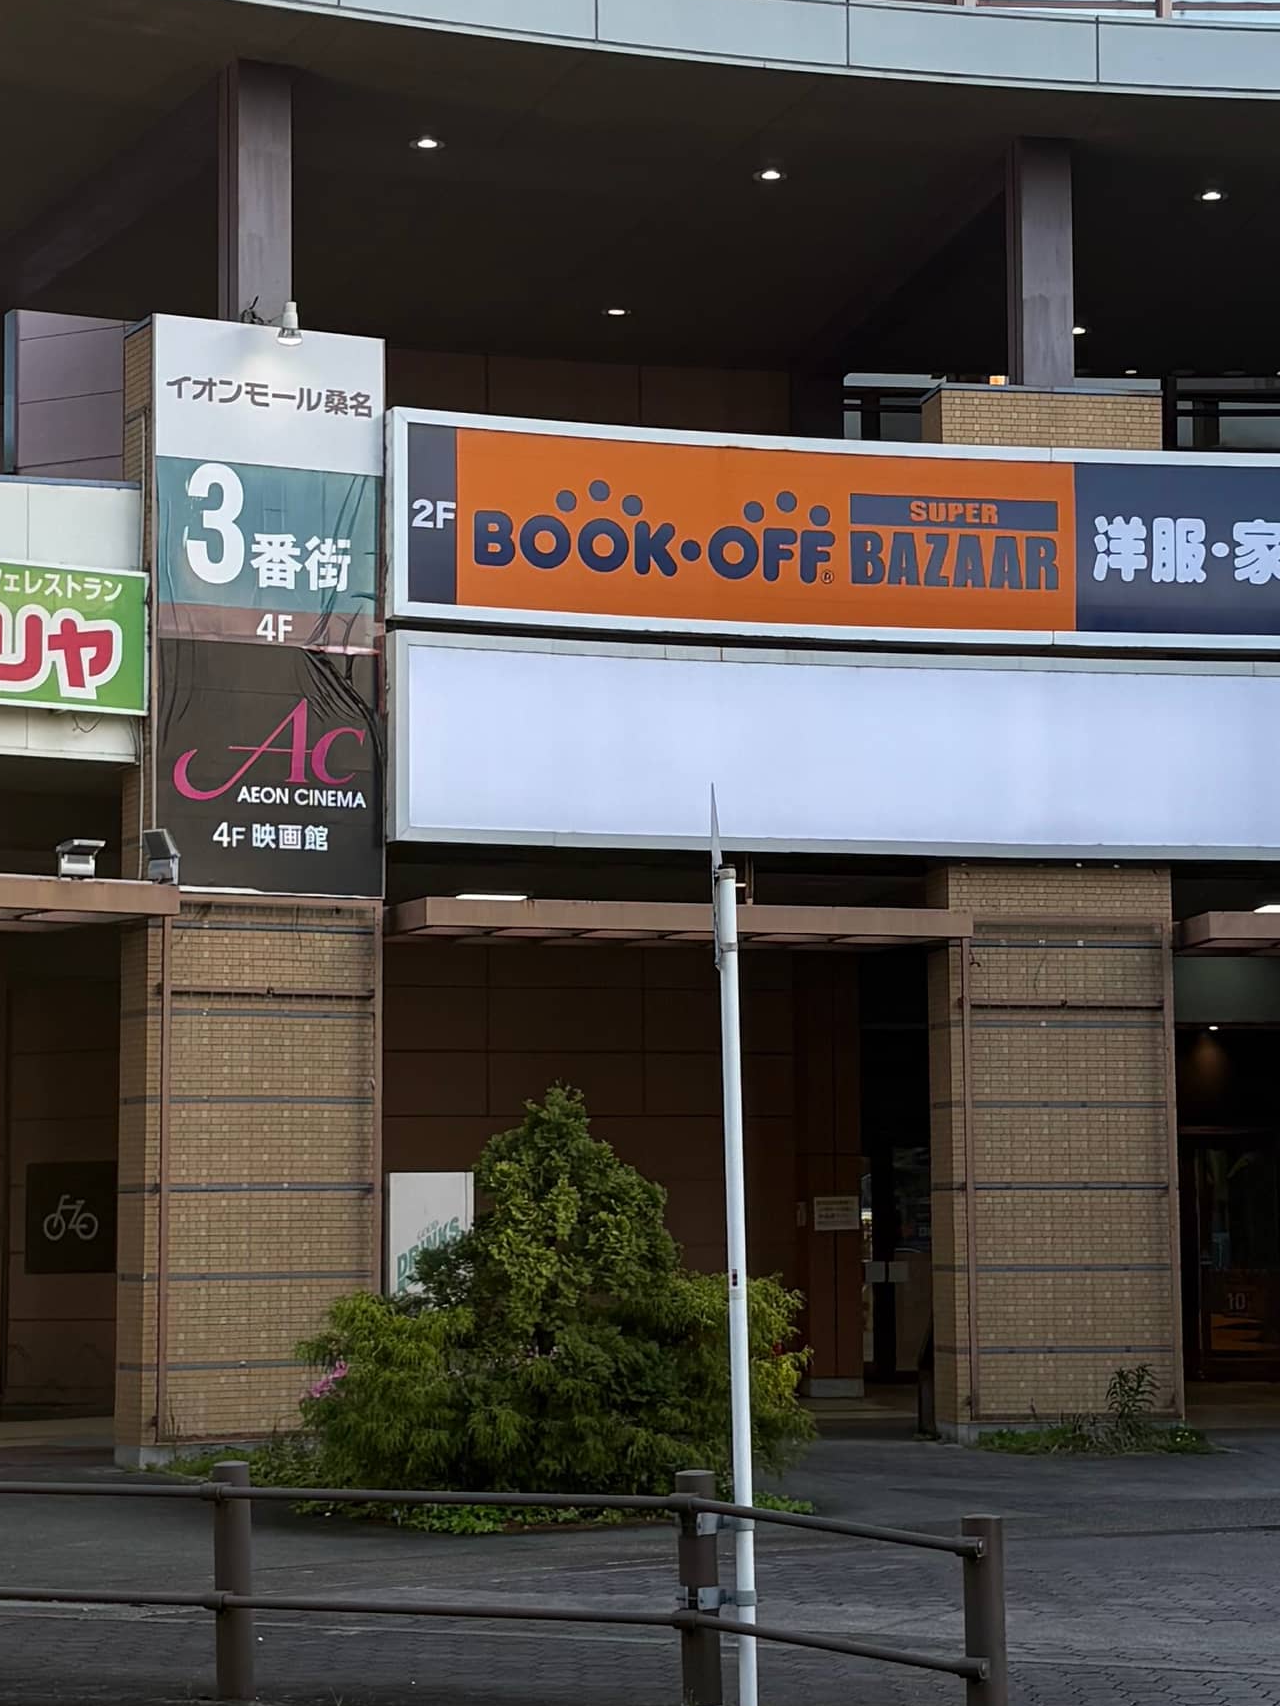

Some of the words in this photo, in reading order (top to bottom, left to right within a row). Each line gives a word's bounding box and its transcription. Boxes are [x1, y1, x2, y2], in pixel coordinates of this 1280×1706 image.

[166, 376, 373, 418] イオンモール桑名
[411, 499, 456, 530] 2F
[909, 500, 1000, 525] SUPER
[849, 531, 1061, 591] BAZAAR
[256, 614, 294, 642] 4F
[236, 785, 290, 805] AEON
[294, 789, 367, 809] CINEMA
[212, 822, 246, 848] 4F
[252, 823, 329, 852] 映画館
